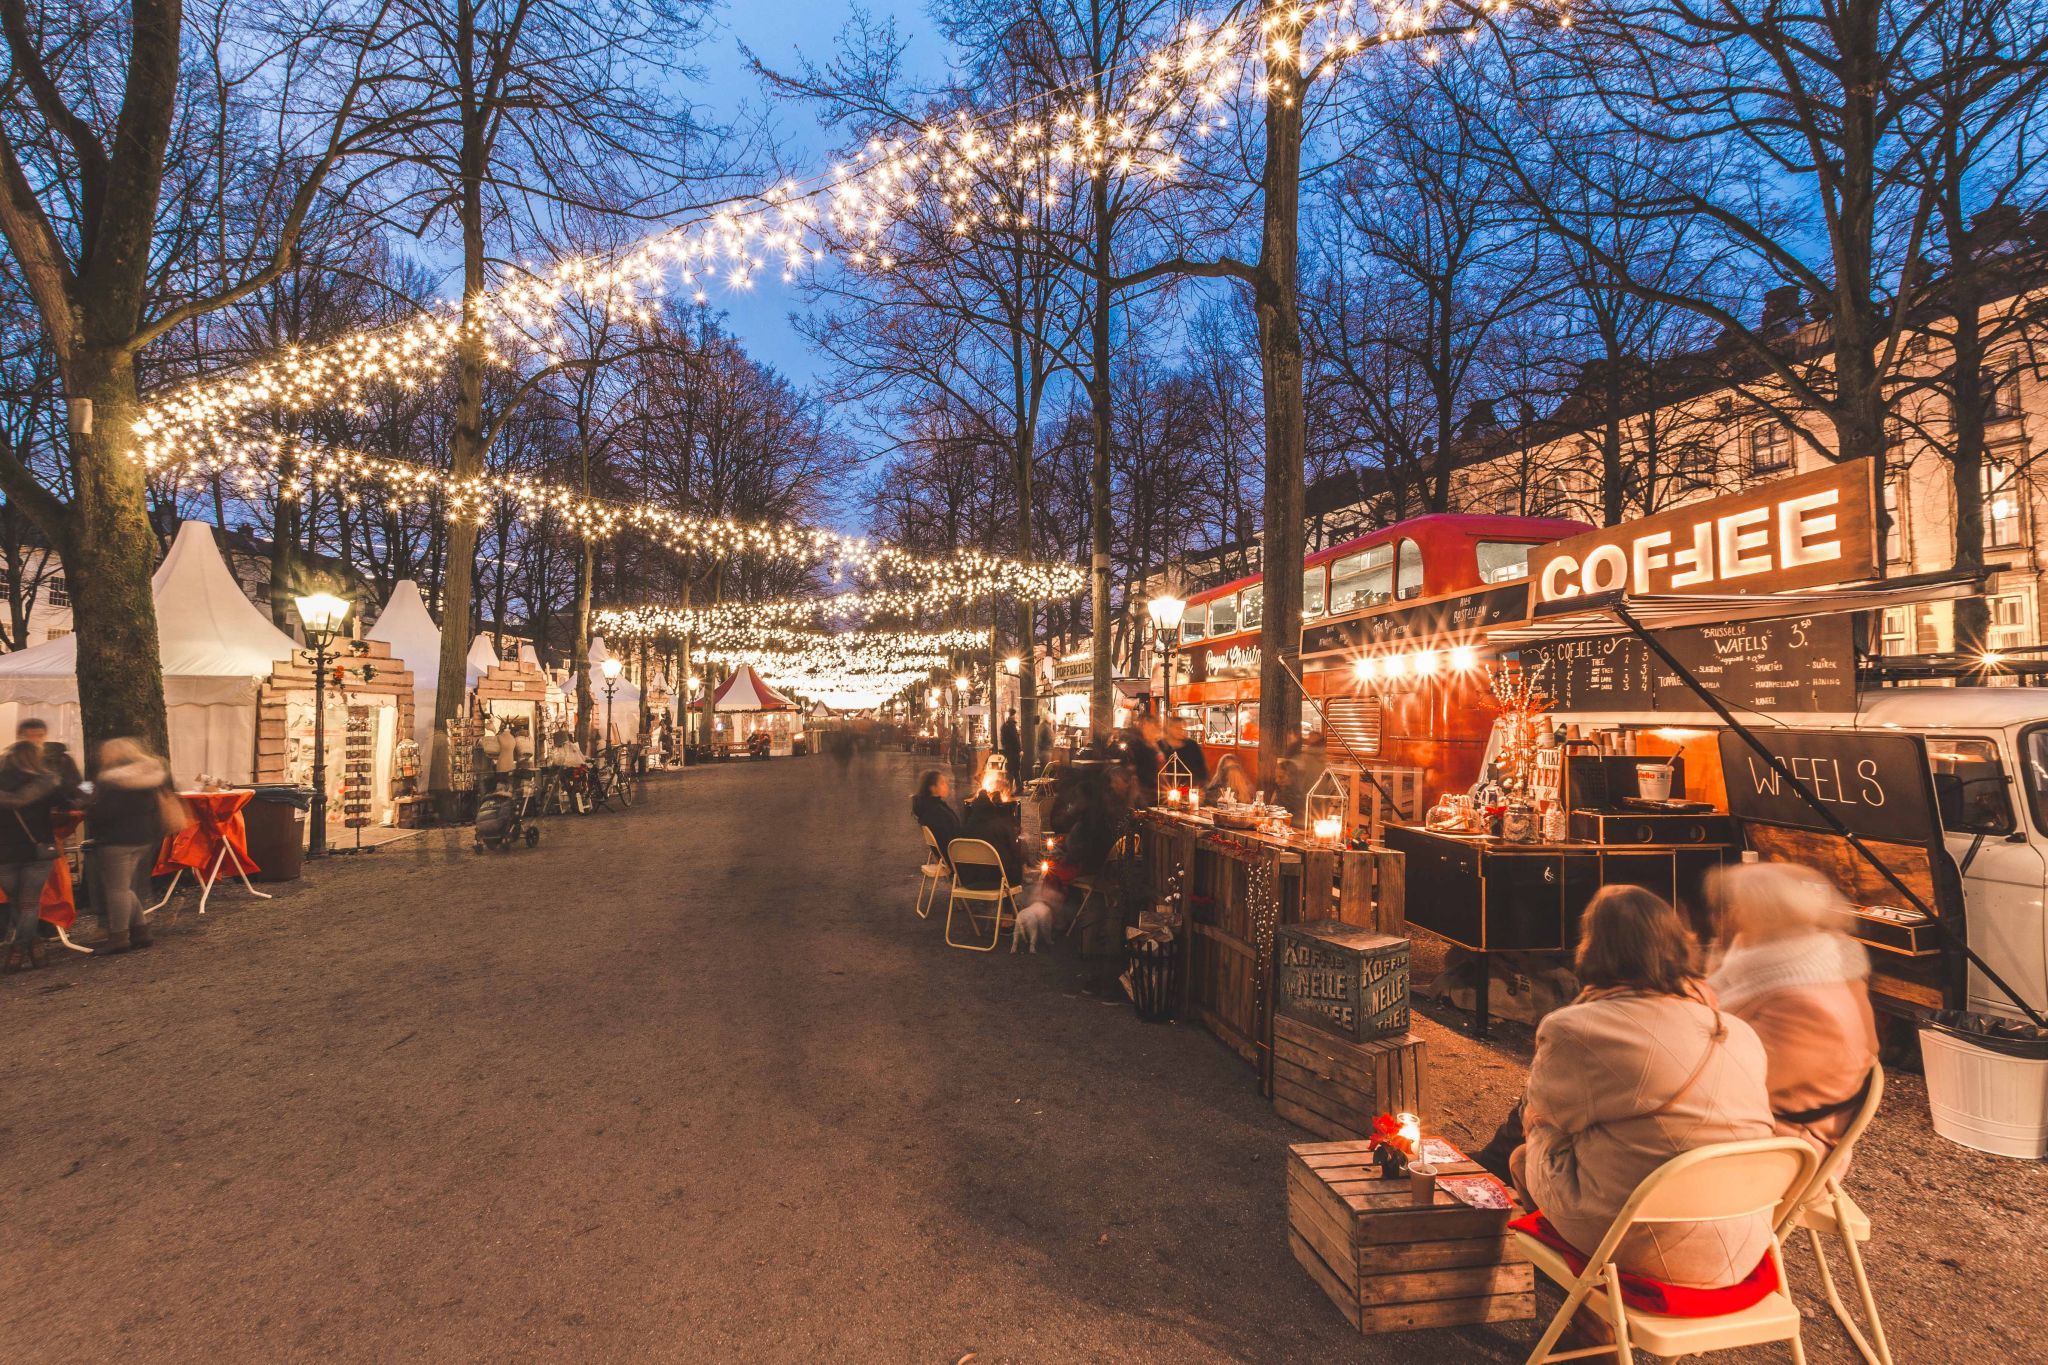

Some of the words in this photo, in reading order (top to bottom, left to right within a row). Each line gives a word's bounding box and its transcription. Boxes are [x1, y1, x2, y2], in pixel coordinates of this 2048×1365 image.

[1541, 489, 1842, 602] COFFEE
[1557, 640, 1593, 661] COFFEE
[1714, 635, 1768, 653] WAFELS
[1205, 649, 1230, 676] Royal
[1748, 756, 1886, 807] WAFELS
[1375, 1004, 1409, 1031] THEE
